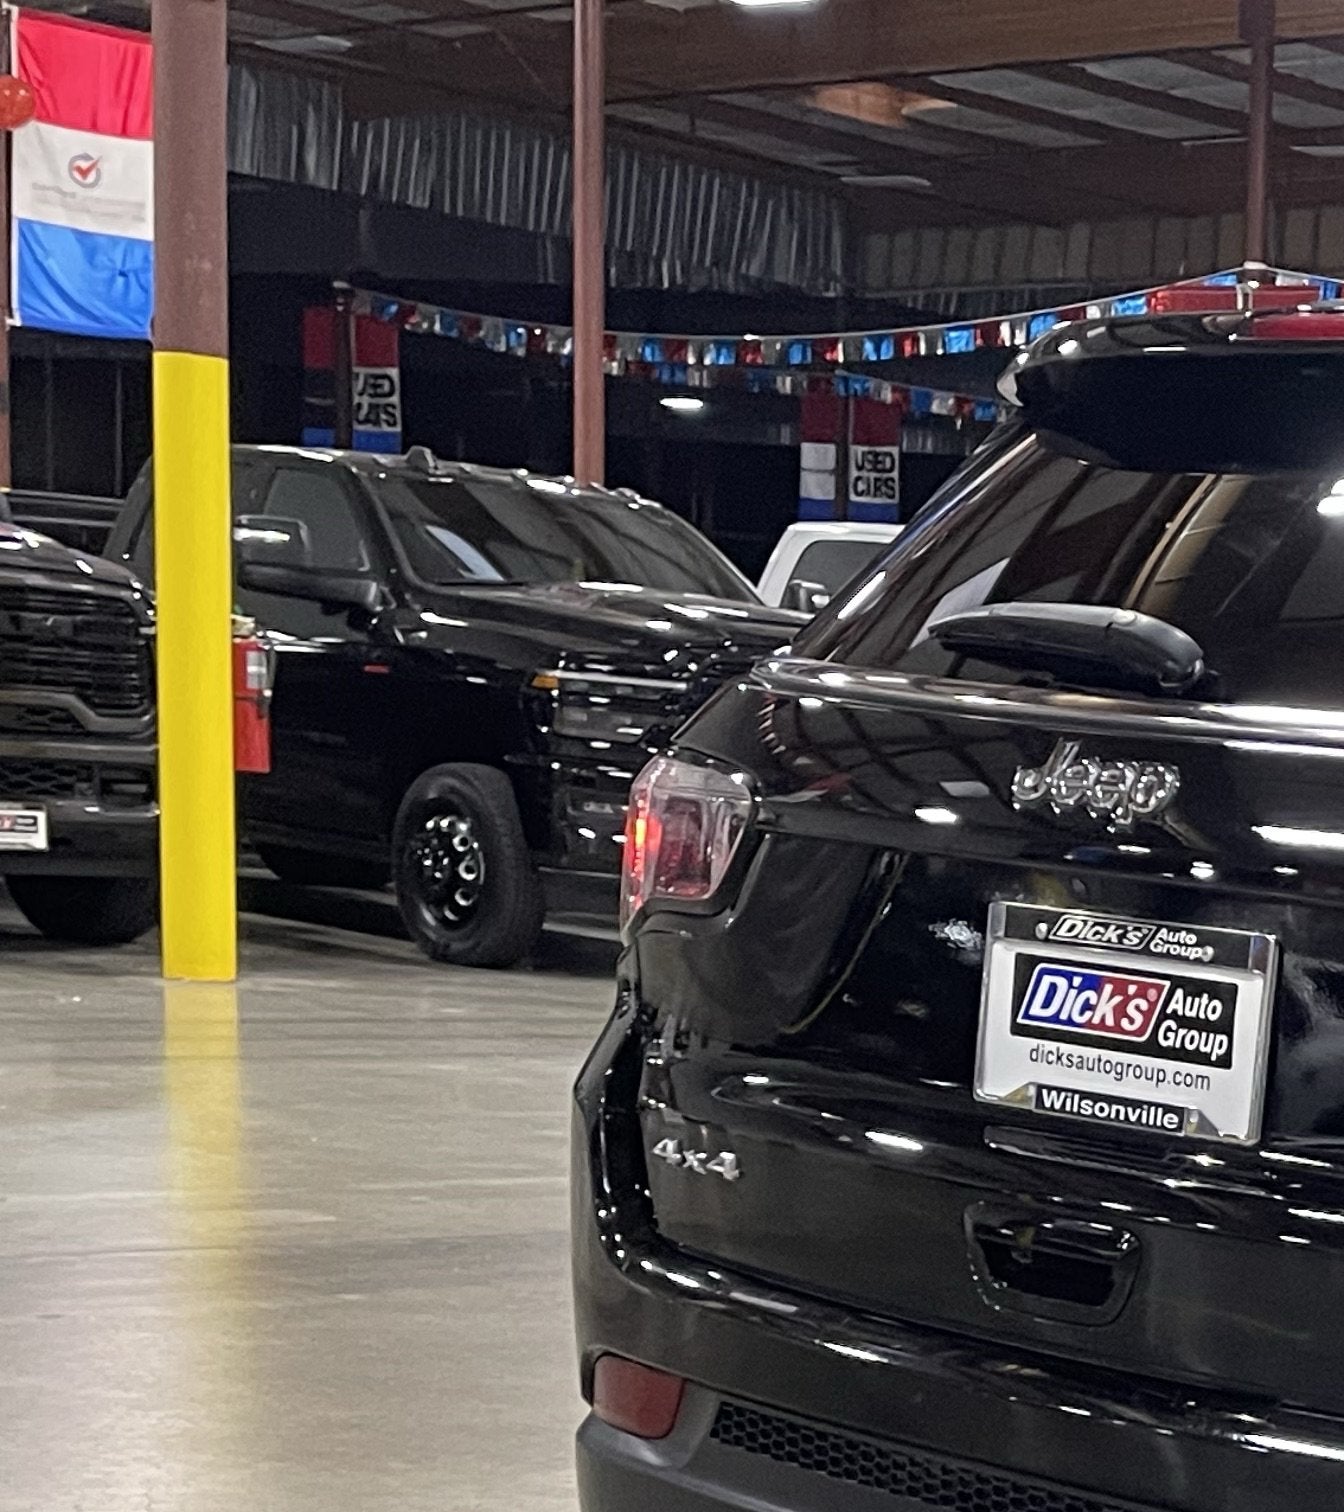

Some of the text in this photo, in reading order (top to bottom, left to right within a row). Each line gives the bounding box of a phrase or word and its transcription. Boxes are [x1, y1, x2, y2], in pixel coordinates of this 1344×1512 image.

[1011, 738, 1182, 834] Jeep
[1055, 918, 1198, 946] Dick's Auto
[1150, 941, 1204, 960] Group
[1028, 974, 1224, 1032] Dick's Auto
[1157, 1019, 1229, 1061] Group
[1029, 1043, 1212, 1091] dicksautogroup.com
[1041, 1088, 1180, 1130] Wilsonville
[651, 1137, 742, 1182] 4x4
